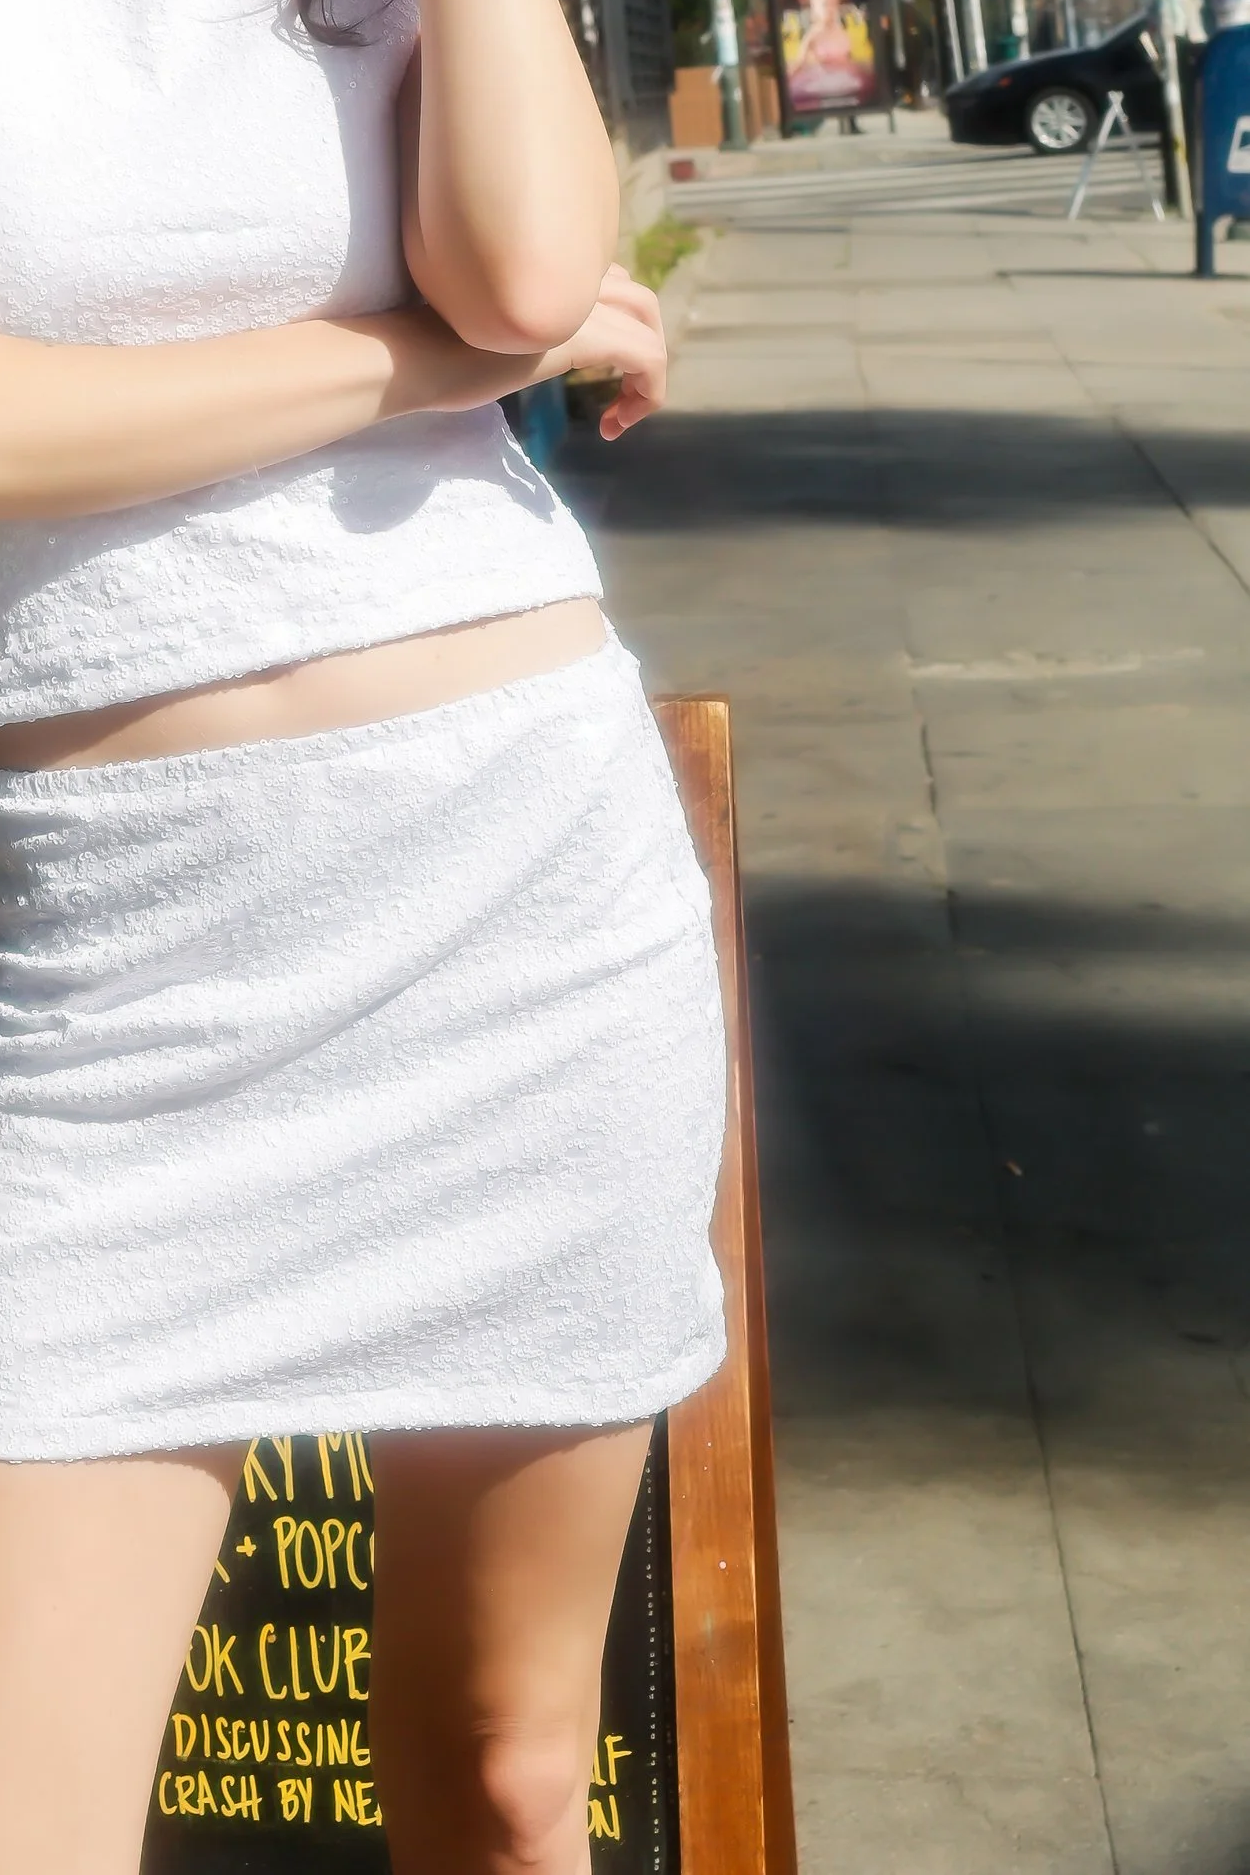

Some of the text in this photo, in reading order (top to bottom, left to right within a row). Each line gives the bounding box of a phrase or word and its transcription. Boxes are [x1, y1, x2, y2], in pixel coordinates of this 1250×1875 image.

[272, 1516, 375, 1591] POPC
[259, 1623, 372, 1701] CLUB
[171, 1713, 633, 1786] DISCUSSING LF
[158, 1771, 262, 1821] CRASH
[277, 1778, 313, 1823] BY
